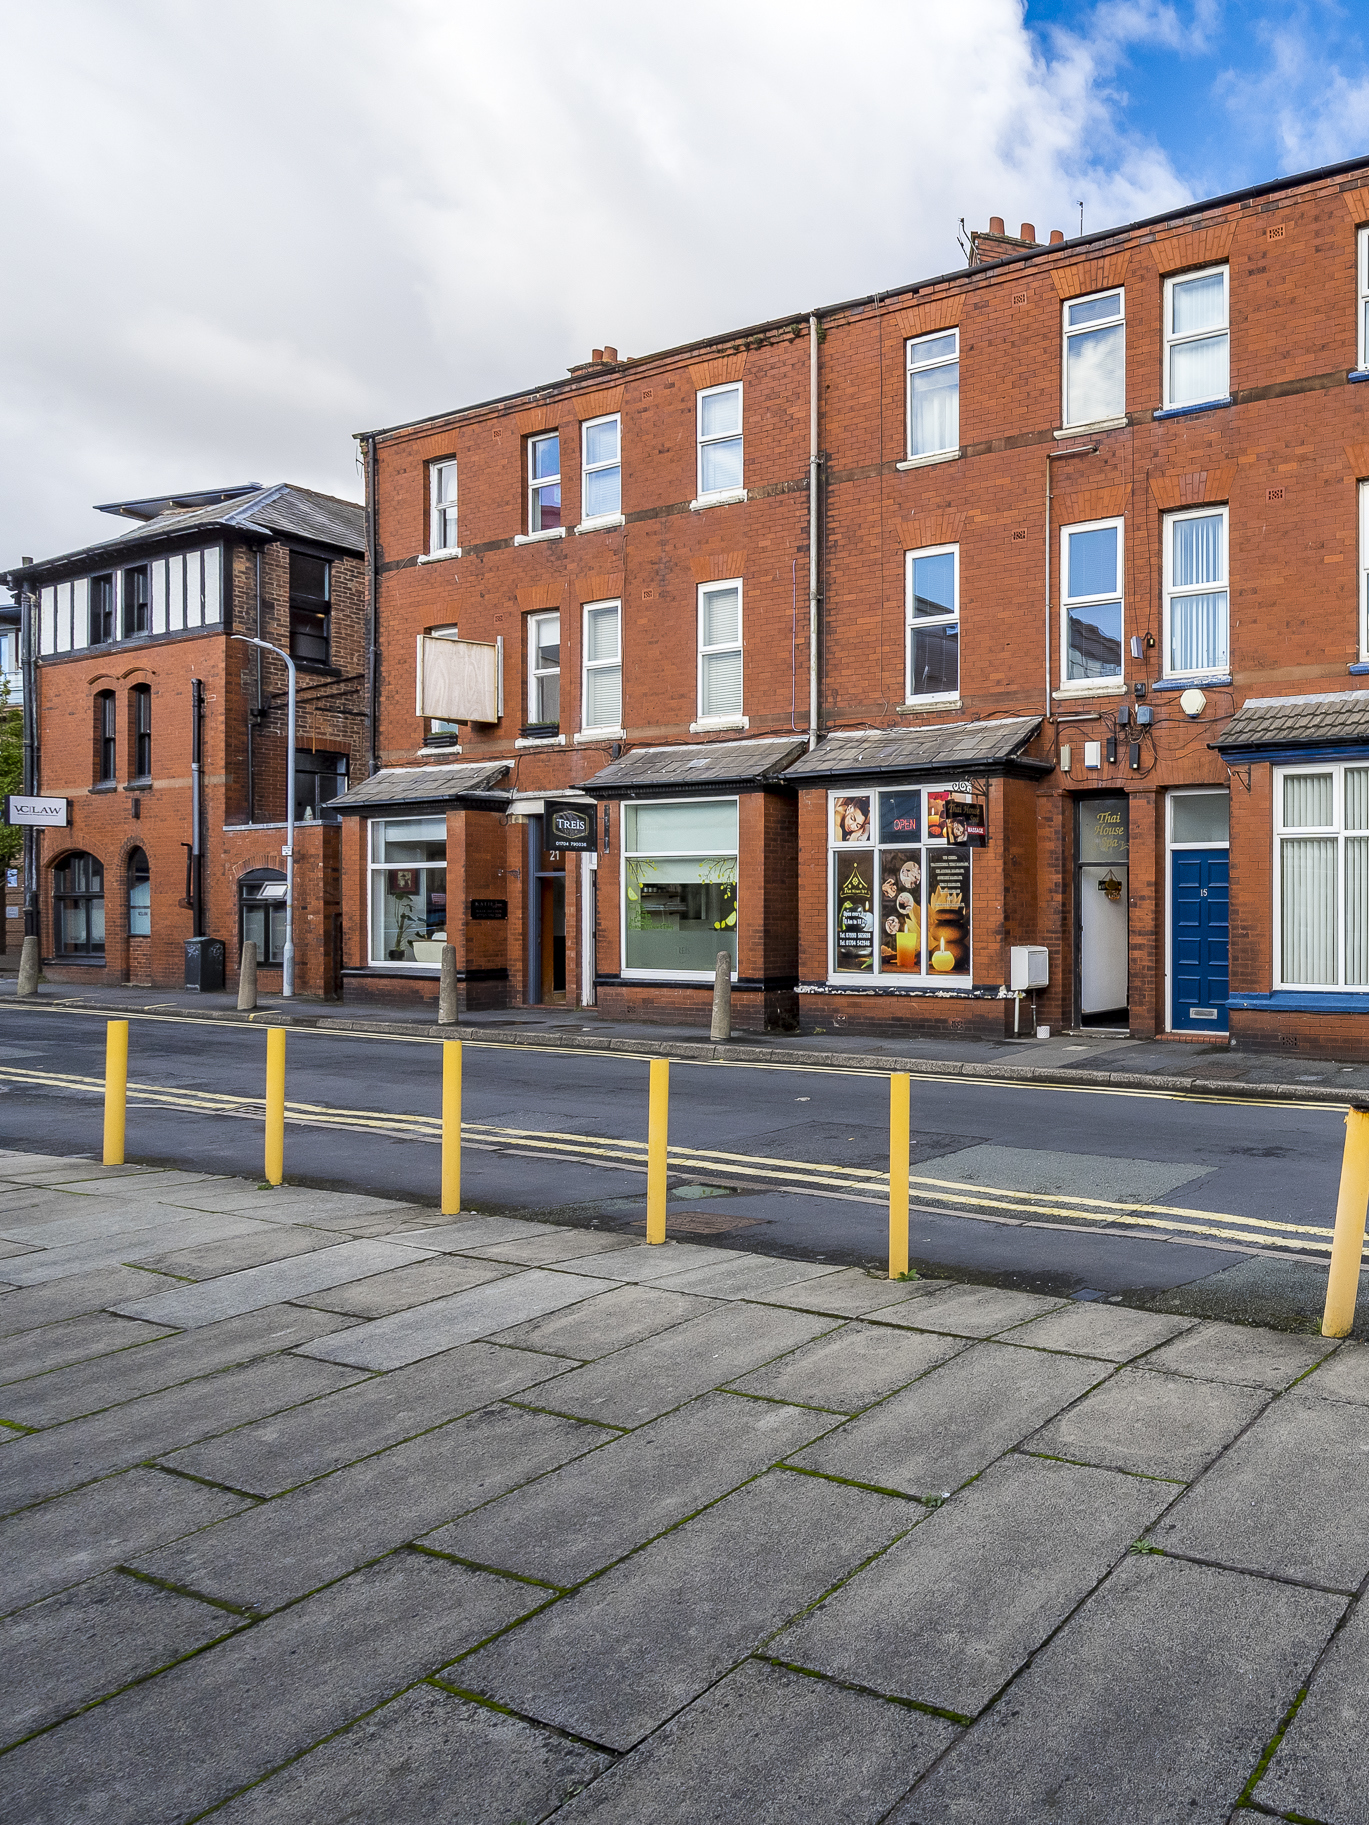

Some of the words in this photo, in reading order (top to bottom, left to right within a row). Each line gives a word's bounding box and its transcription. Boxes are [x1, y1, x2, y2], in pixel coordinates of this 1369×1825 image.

[1097, 811, 1121, 824] Thai
[893, 818, 916, 831] OPEN
[1094, 824, 1124, 835] House
[1101, 837, 1119, 851] Spa
[549, 850, 560, 860] 21
[1200, 888, 1208, 897] 15
